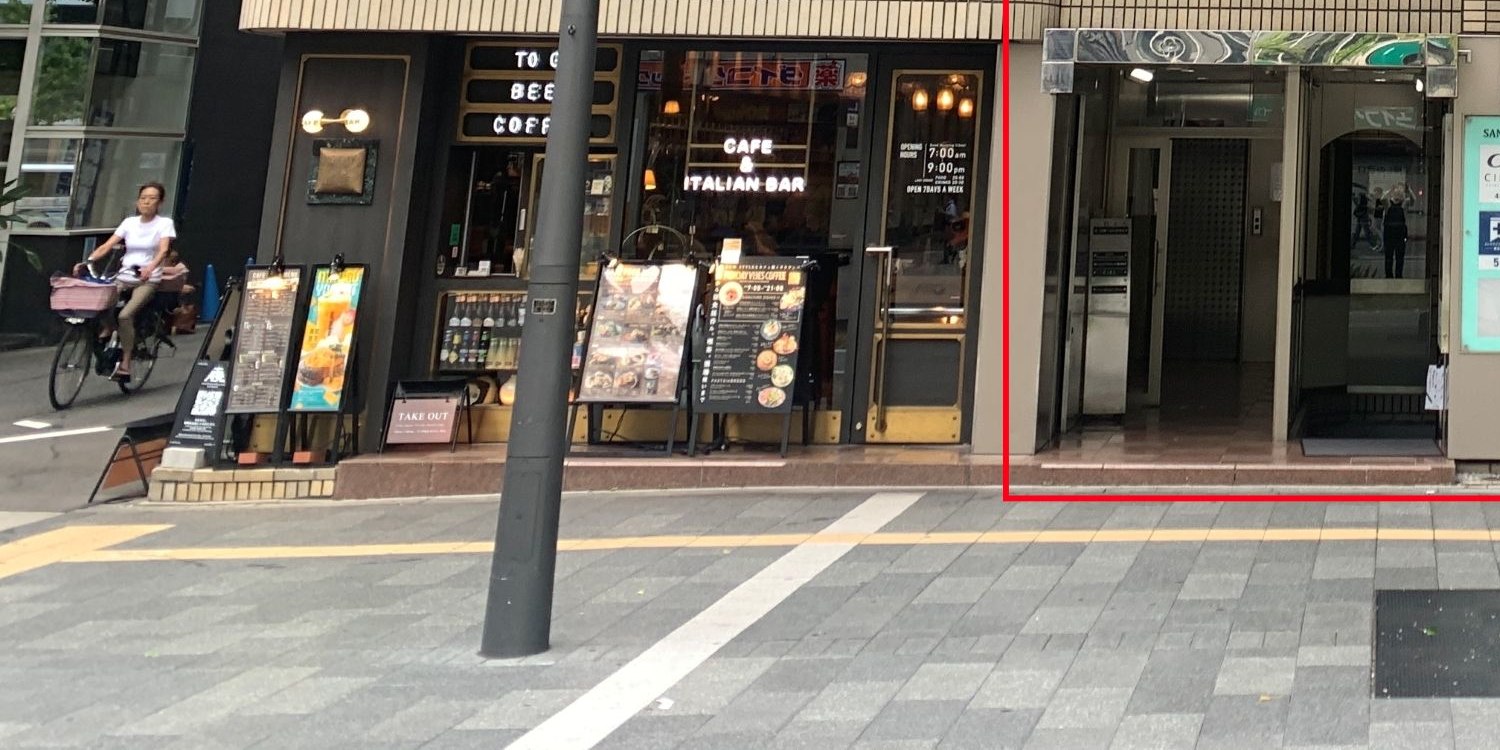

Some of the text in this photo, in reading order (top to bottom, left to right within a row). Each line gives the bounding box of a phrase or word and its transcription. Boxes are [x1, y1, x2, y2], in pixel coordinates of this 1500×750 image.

[515, 50, 559, 68] TO G
[510, 82, 556, 101] BEE
[493, 114, 551, 135] COFF
[723, 138, 773, 154] CAFE
[739, 155, 754, 173] &
[684, 176, 805, 192] ITALIAN BAR
[906, 185, 922, 193] OPEN
[947, 185, 964, 193] WEEK
[399, 411, 449, 421] TAKE OUT
